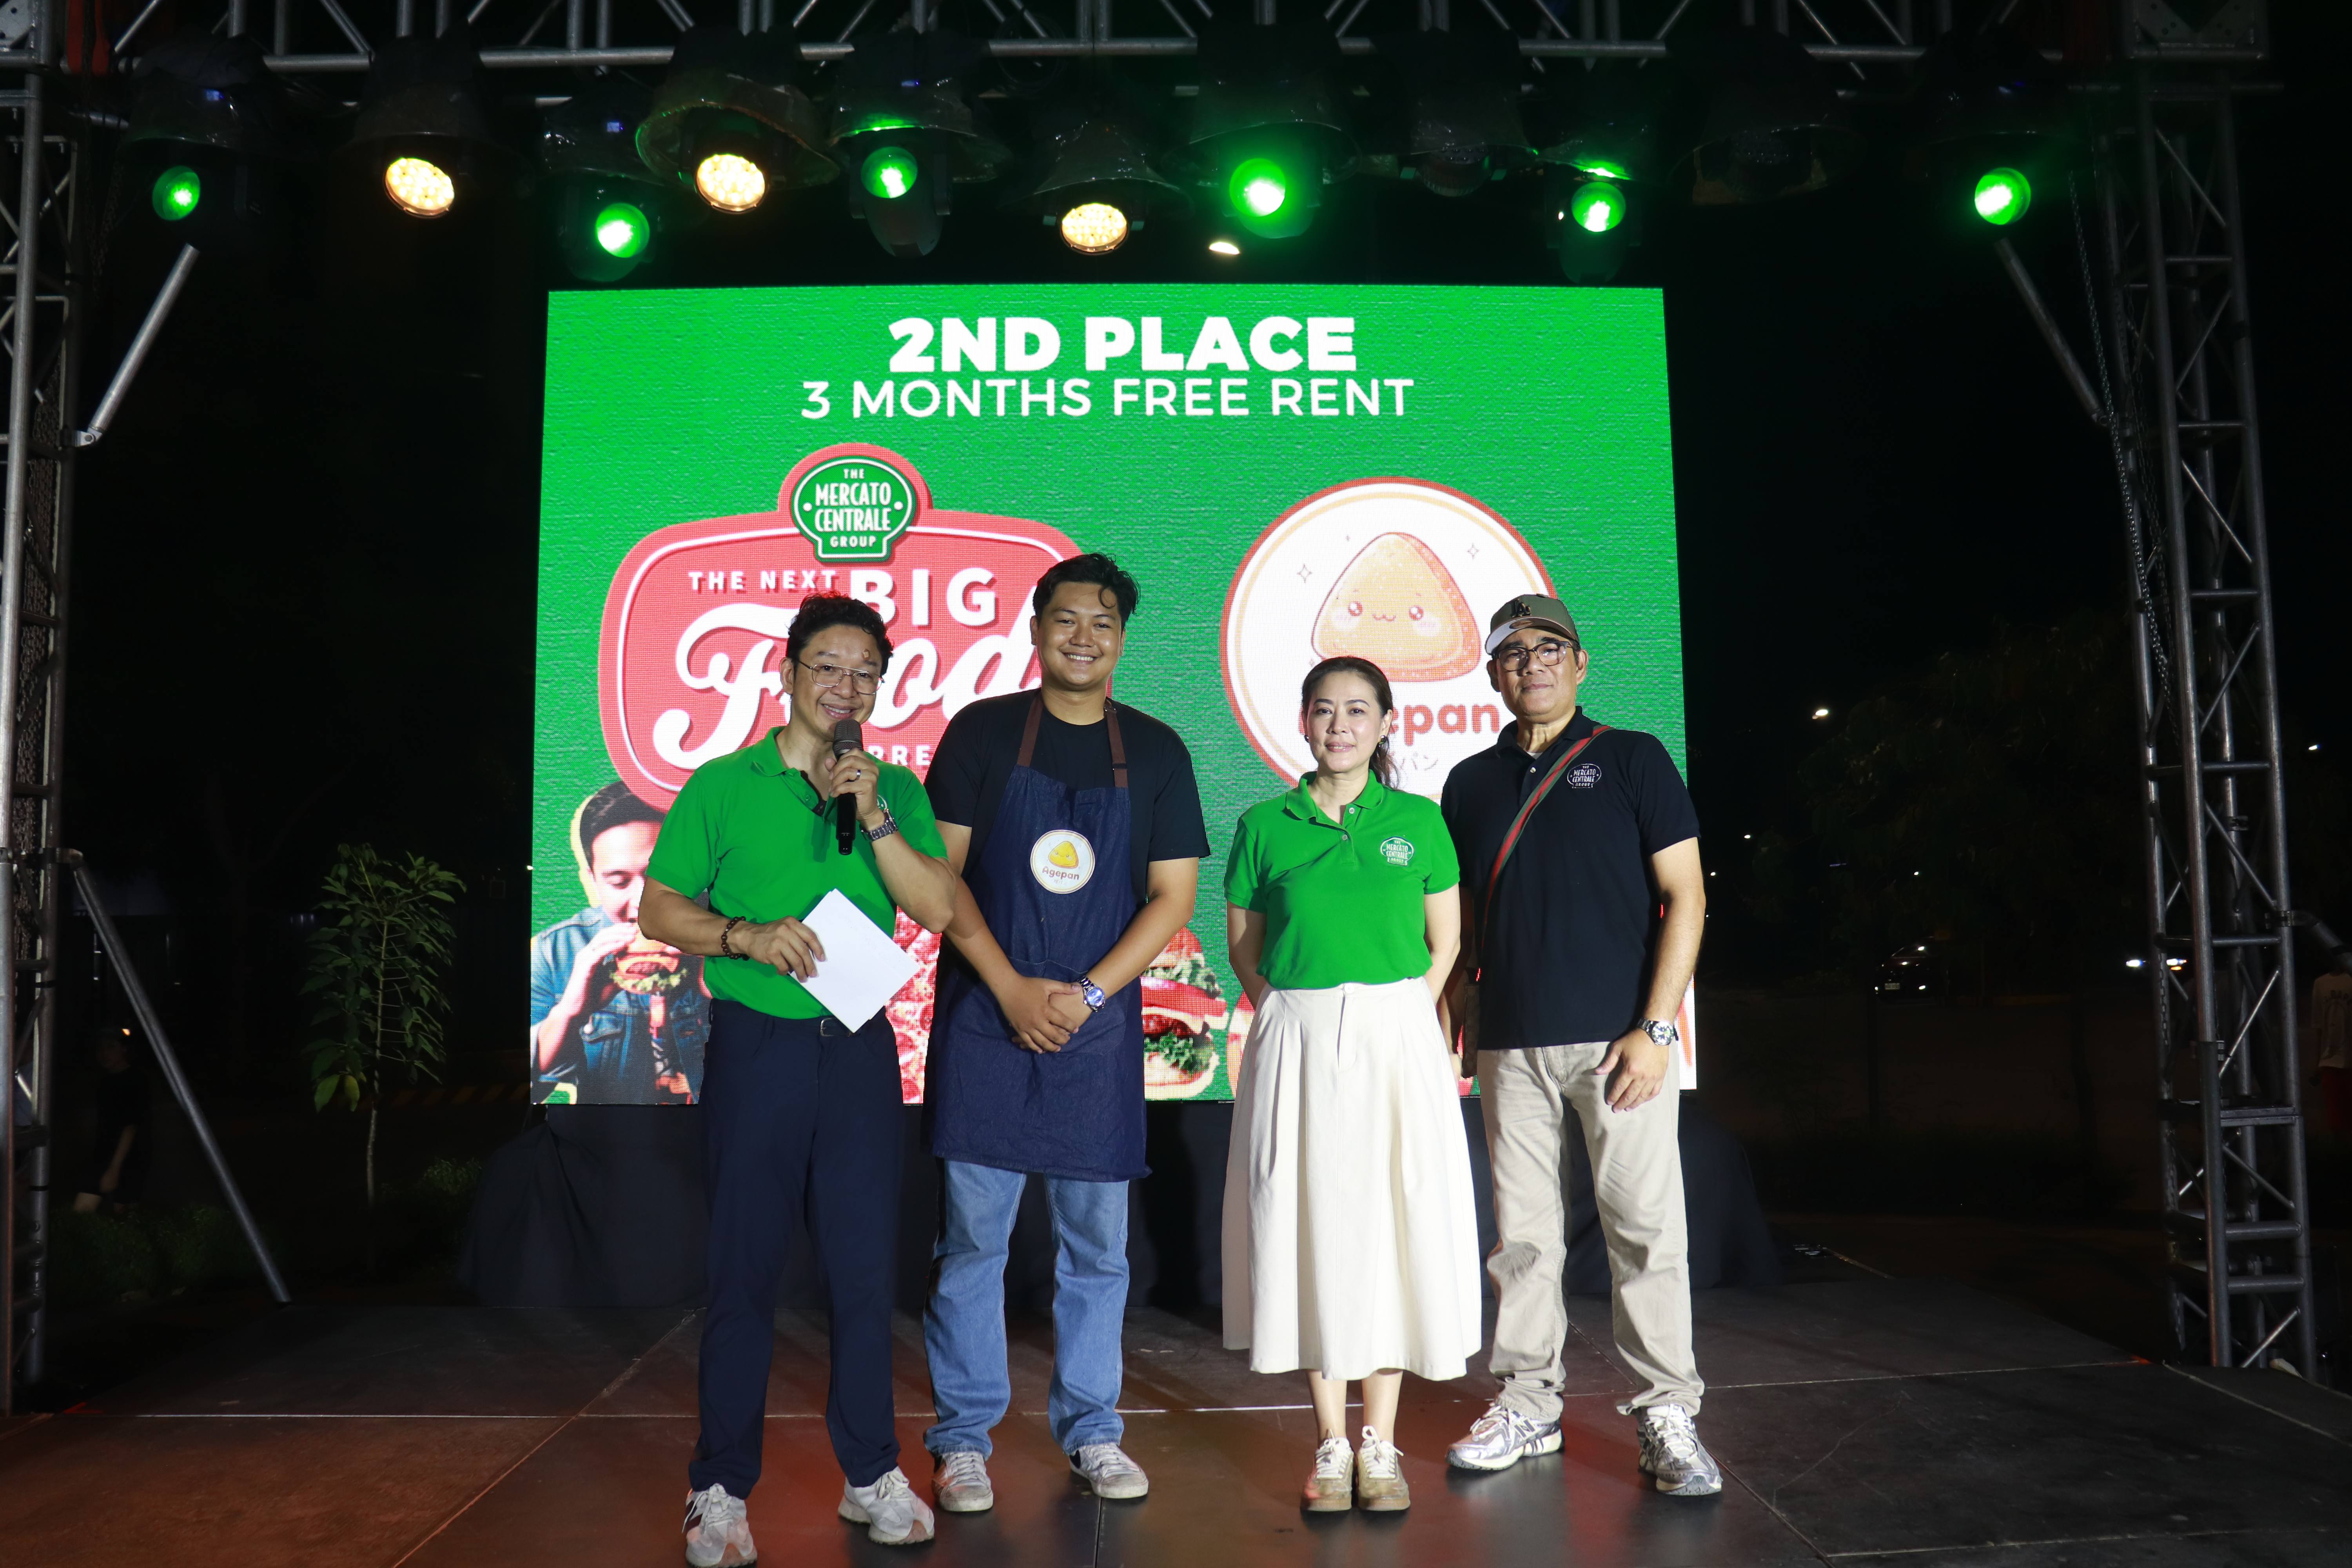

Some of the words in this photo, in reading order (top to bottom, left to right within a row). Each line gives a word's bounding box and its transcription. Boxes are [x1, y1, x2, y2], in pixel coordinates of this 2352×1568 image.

[889, 317, 1061, 372] 2ND
[1085, 316, 1357, 372] PLACE
[801, 381, 831, 419] 3
[852, 377, 1091, 419] MONTHS
[1113, 377, 1250, 416] FREE
[1271, 377, 1415, 417] RENT
[844, 468, 865, 479] THE
[815, 481, 892, 506] MERCATO
[814, 507, 892, 532] CENTRALE
[829, 535, 877, 548] GROUP
[688, 571, 744, 590] THE
[760, 570, 836, 589] NEXT
[850, 567, 996, 626] BIG
[1386, 844, 1408, 852] MERCATO
[1386, 851, 1408, 860] CENTRALE
[1042, 866, 1080, 880] Agepan
